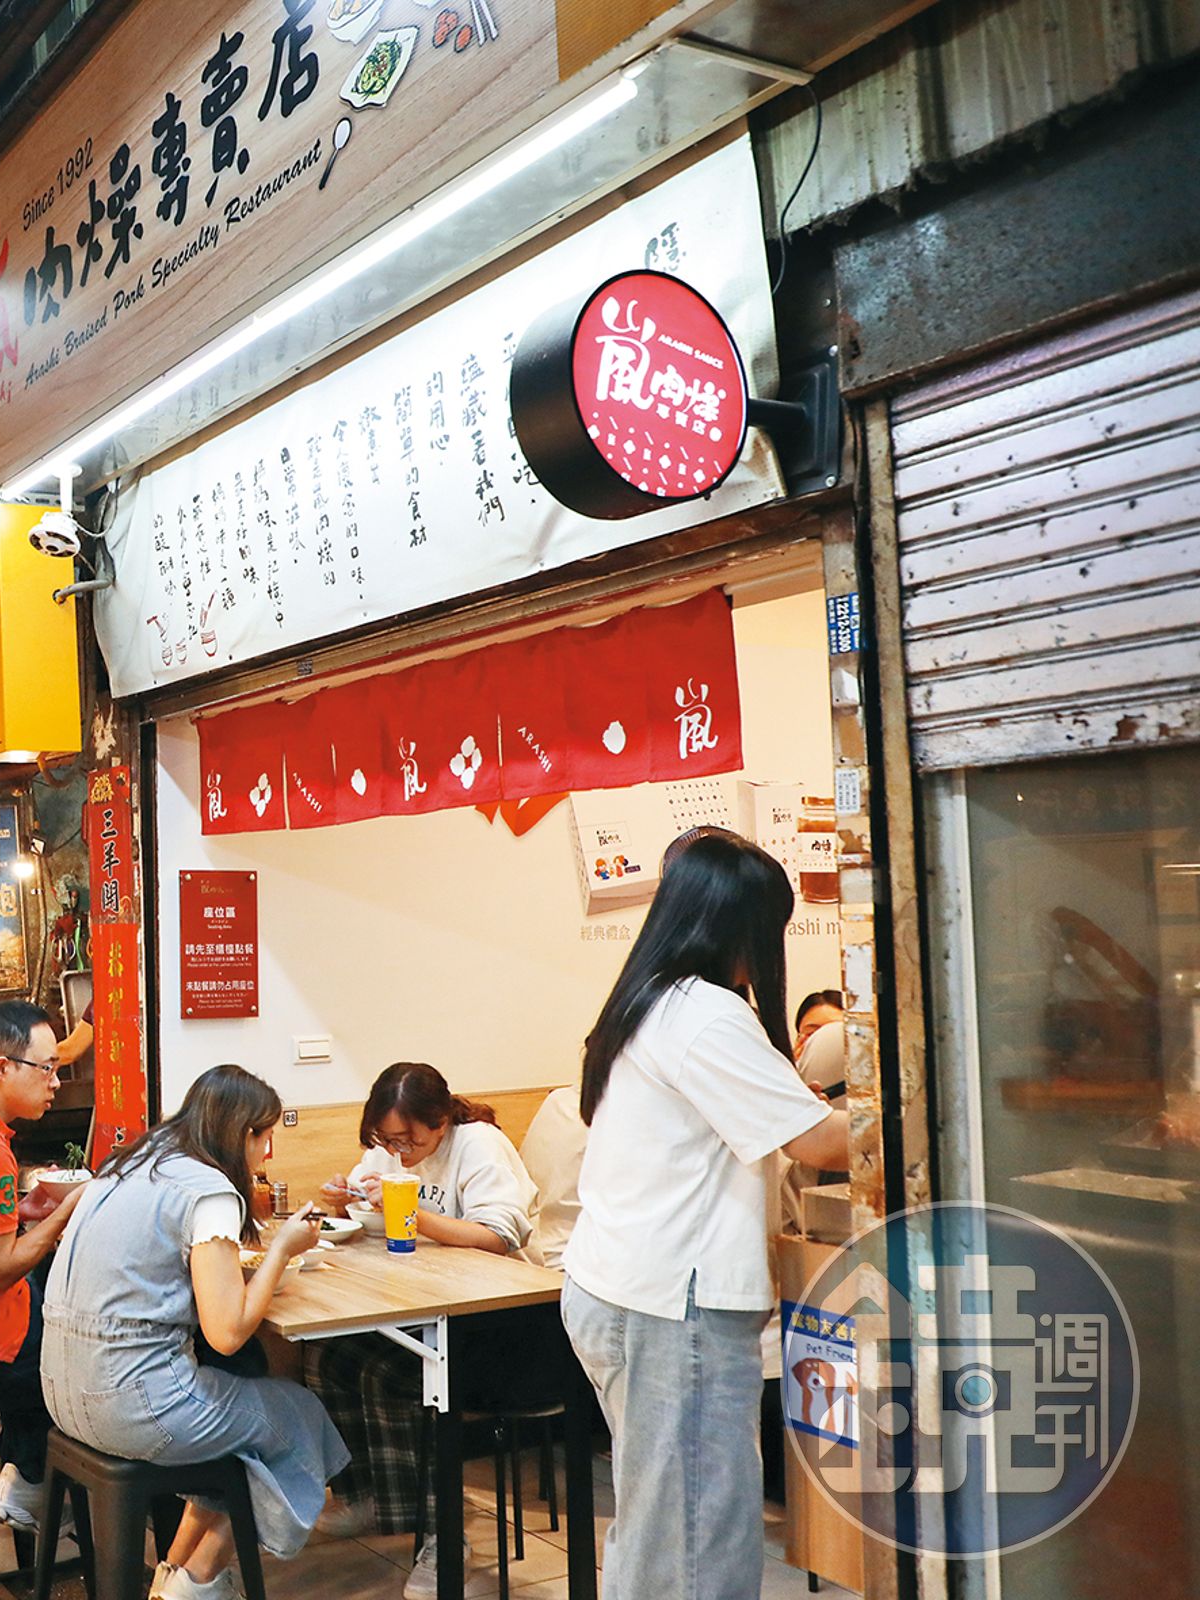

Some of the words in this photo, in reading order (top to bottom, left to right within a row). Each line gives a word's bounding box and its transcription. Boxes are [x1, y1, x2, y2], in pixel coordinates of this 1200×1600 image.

[22, 183, 56, 232] Since
[57, 136, 94, 196] 1992
[112, 274, 146, 320] Pork
[151, 219, 220, 289] Specialty
[224, 137, 322, 226] Restaurant
[517, 725, 553, 774] ARASHI
[674, 676, 719, 760] 嵐
[205, 772, 228, 822] 嵐
[291, 770, 324, 814] ARASHI
[101, 809, 121, 923] 三羊開
